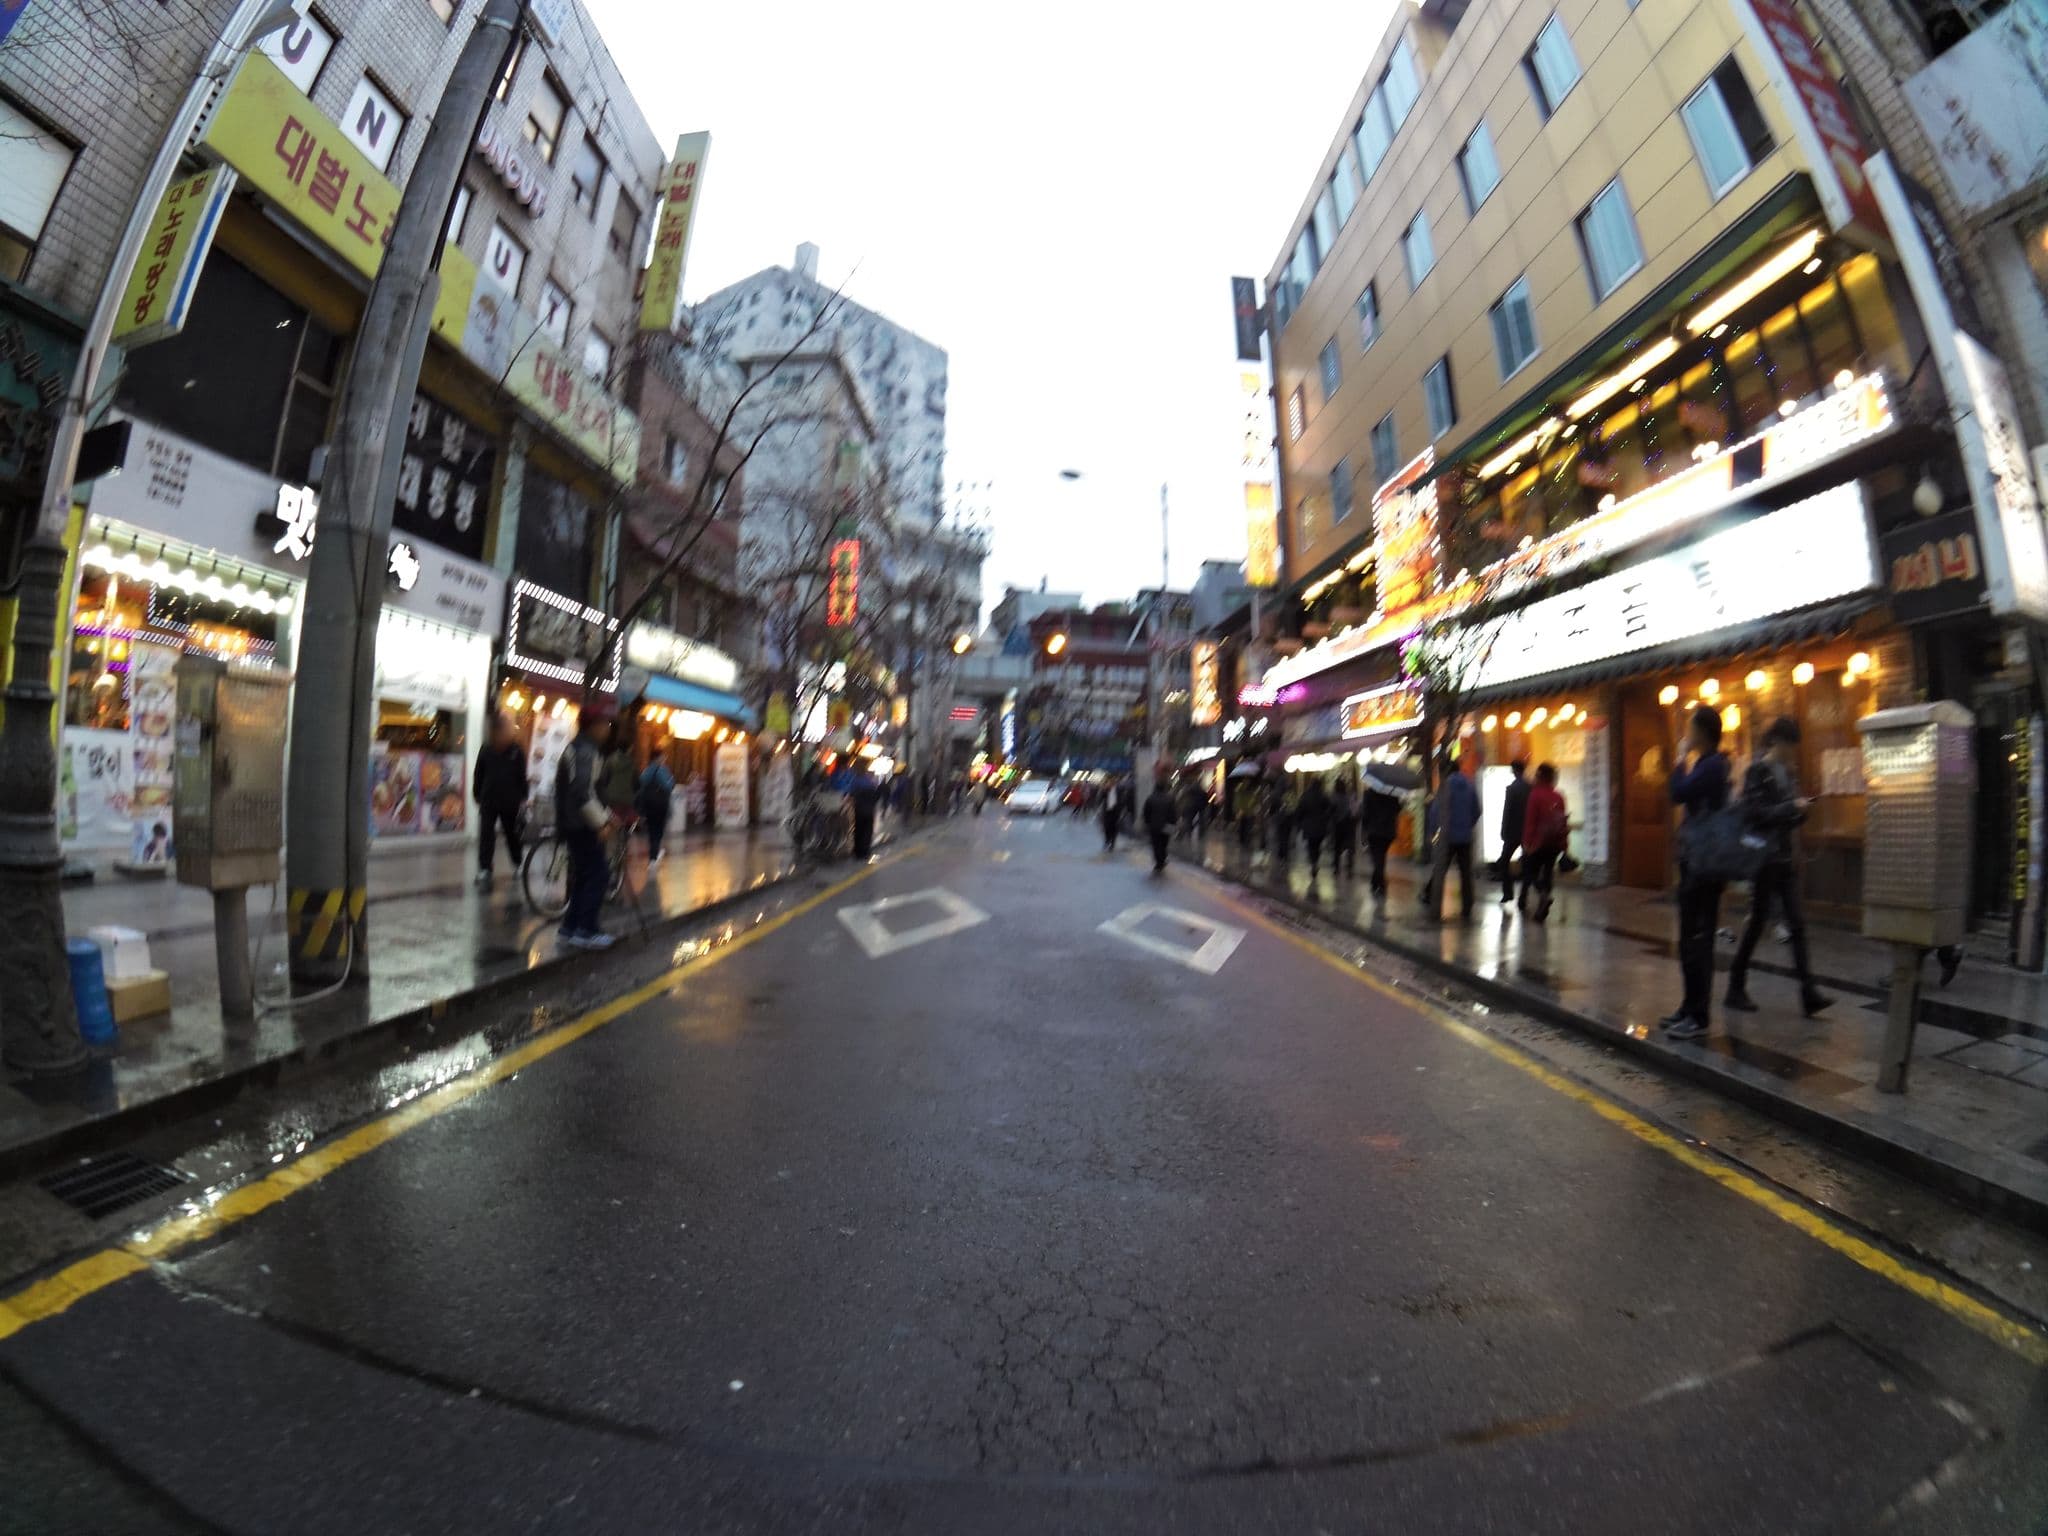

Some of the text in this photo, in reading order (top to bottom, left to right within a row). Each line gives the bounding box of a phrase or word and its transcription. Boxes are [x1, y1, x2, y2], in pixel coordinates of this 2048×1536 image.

[282, 17, 386, 148] U N
[494, 239, 512, 277] U
